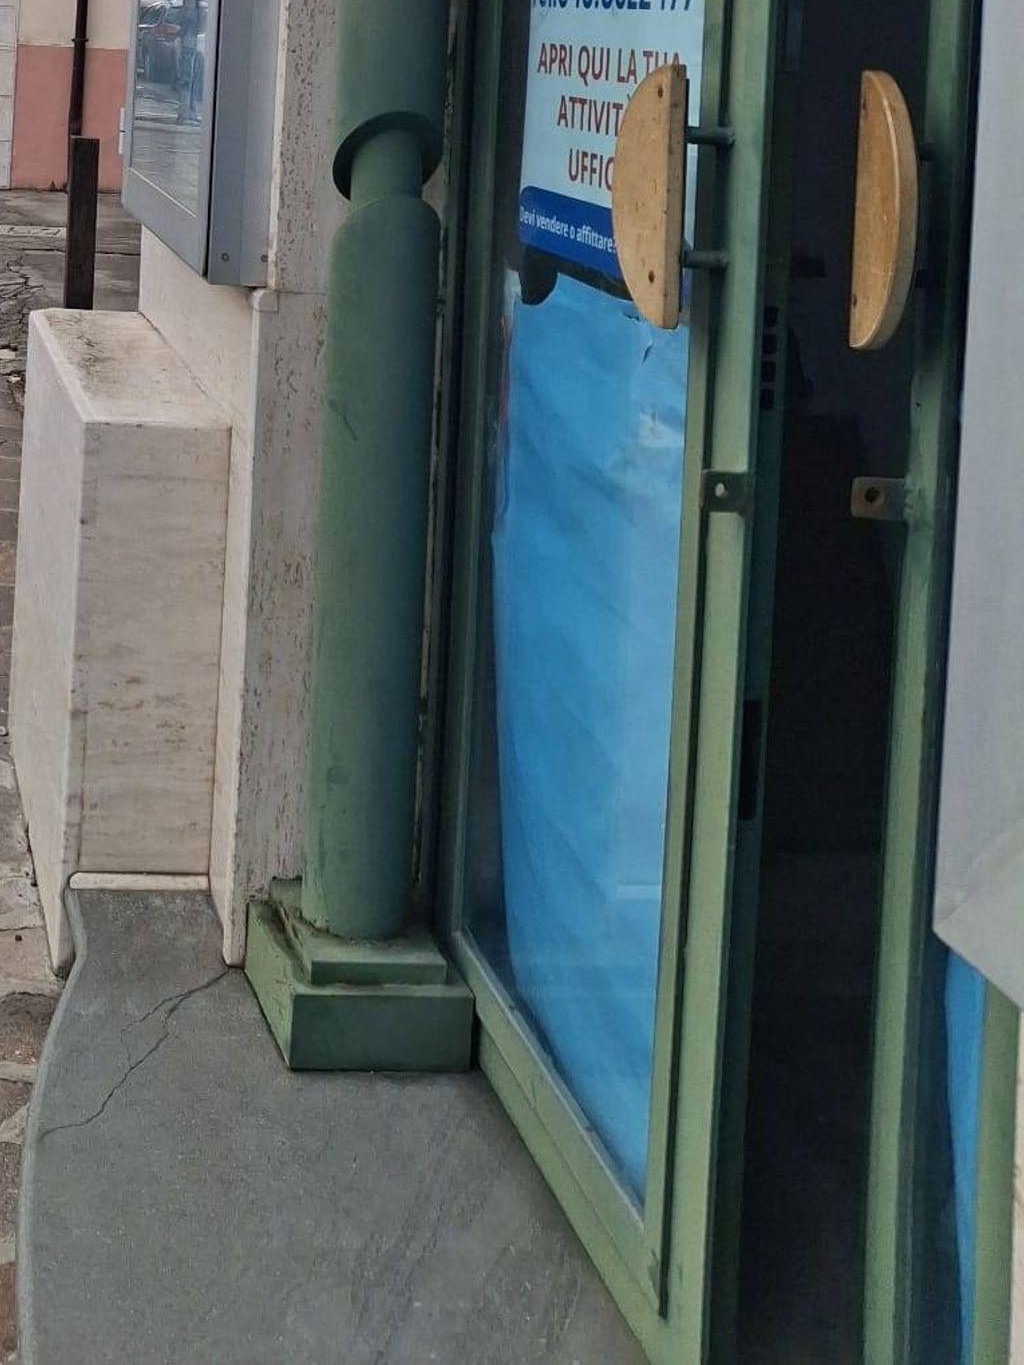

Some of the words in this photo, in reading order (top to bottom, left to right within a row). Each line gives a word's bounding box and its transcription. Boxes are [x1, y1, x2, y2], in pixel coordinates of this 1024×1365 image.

[537, 42, 573, 77] APRI
[578, 45, 610, 86] QUI
[617, 48, 638, 84] LA
[557, 93, 632, 137] ATTIVIT
[568, 148, 615, 192] UFFIC
[536, 215, 569, 238] vendere
[569, 225, 576, 240] o
